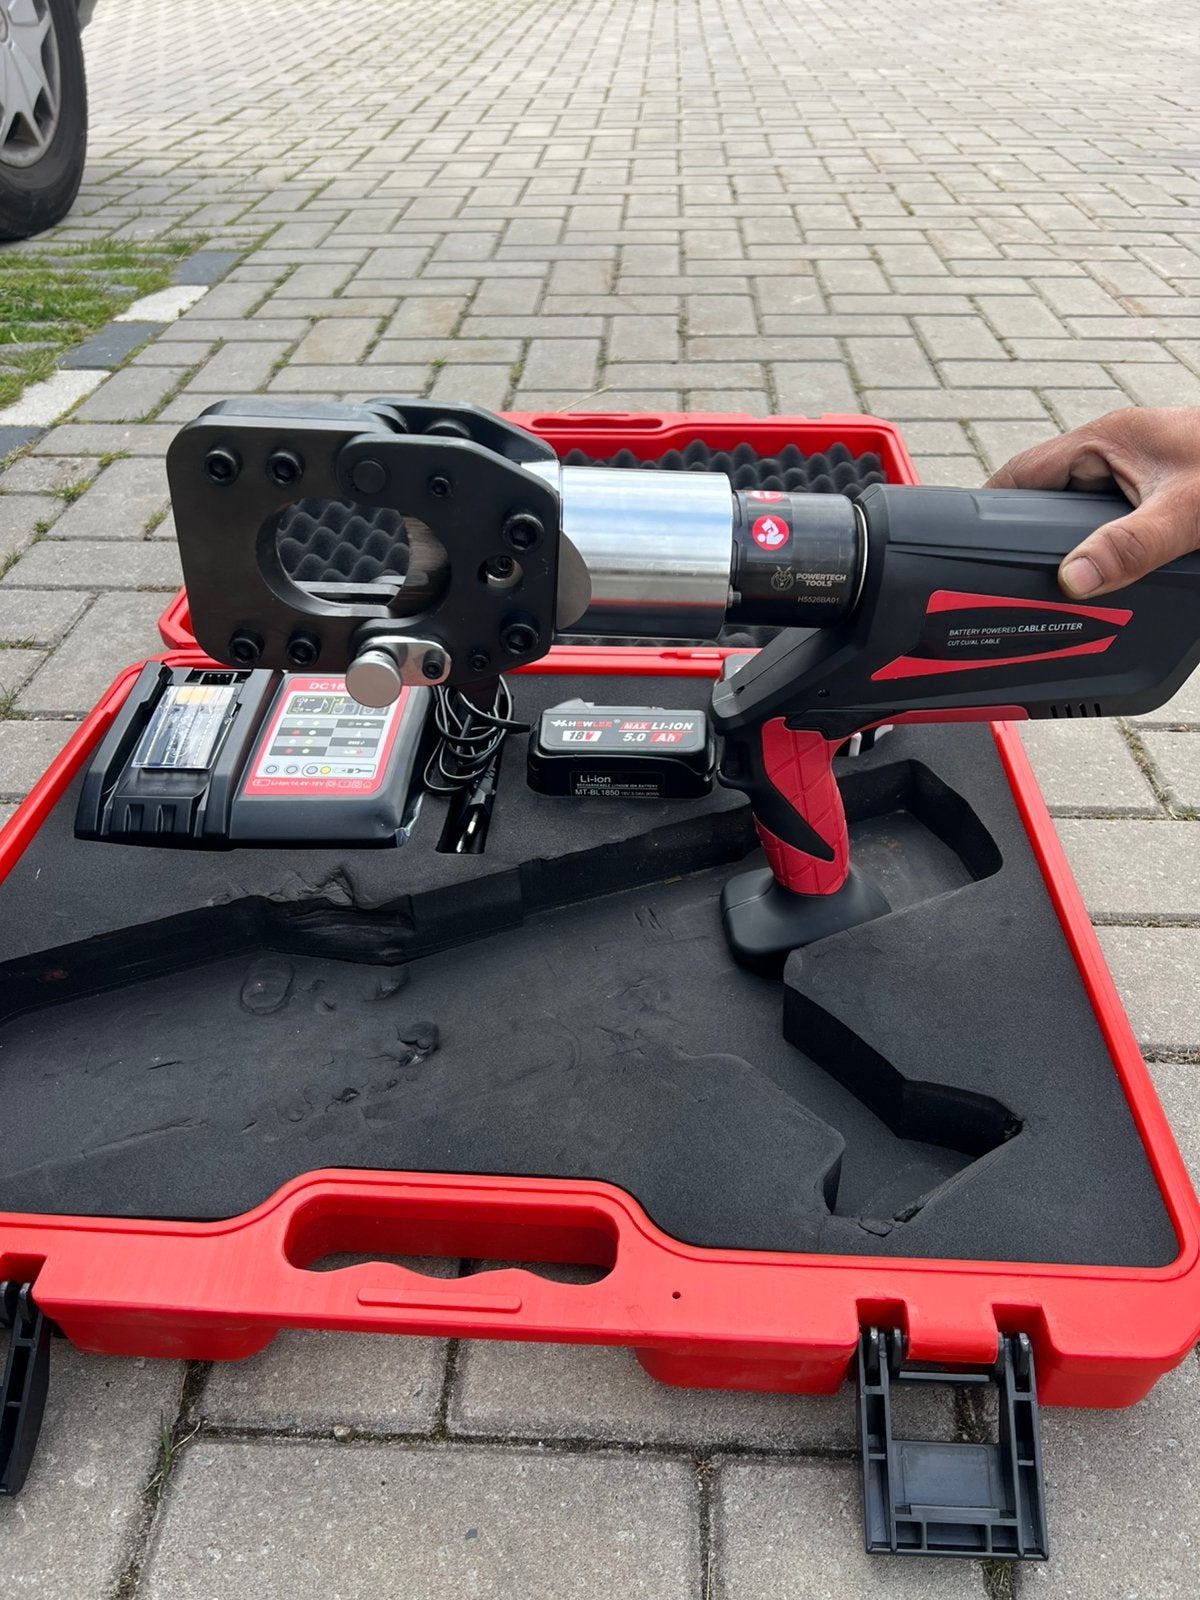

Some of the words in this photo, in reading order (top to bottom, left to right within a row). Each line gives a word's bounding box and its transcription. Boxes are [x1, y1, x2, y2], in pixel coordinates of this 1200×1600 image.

[796, 573, 847, 582] POWERTECH
[948, 628, 981, 636] BATTERY
[981, 626, 1017, 635] POWERED
[1017, 624, 1047, 633] CABLE
[1048, 622, 1083, 632] CUTTER
[308, 682, 347, 691] DC18
[568, 720, 613, 728] HEWLEE
[624, 722, 649, 730] MAX
[651, 722, 694, 730] LI-ION
[569, 731, 595, 741] 18V
[623, 733, 647, 742] 5.0
[656, 733, 676, 742] Ah
[580, 775, 612, 783] Li-ion
